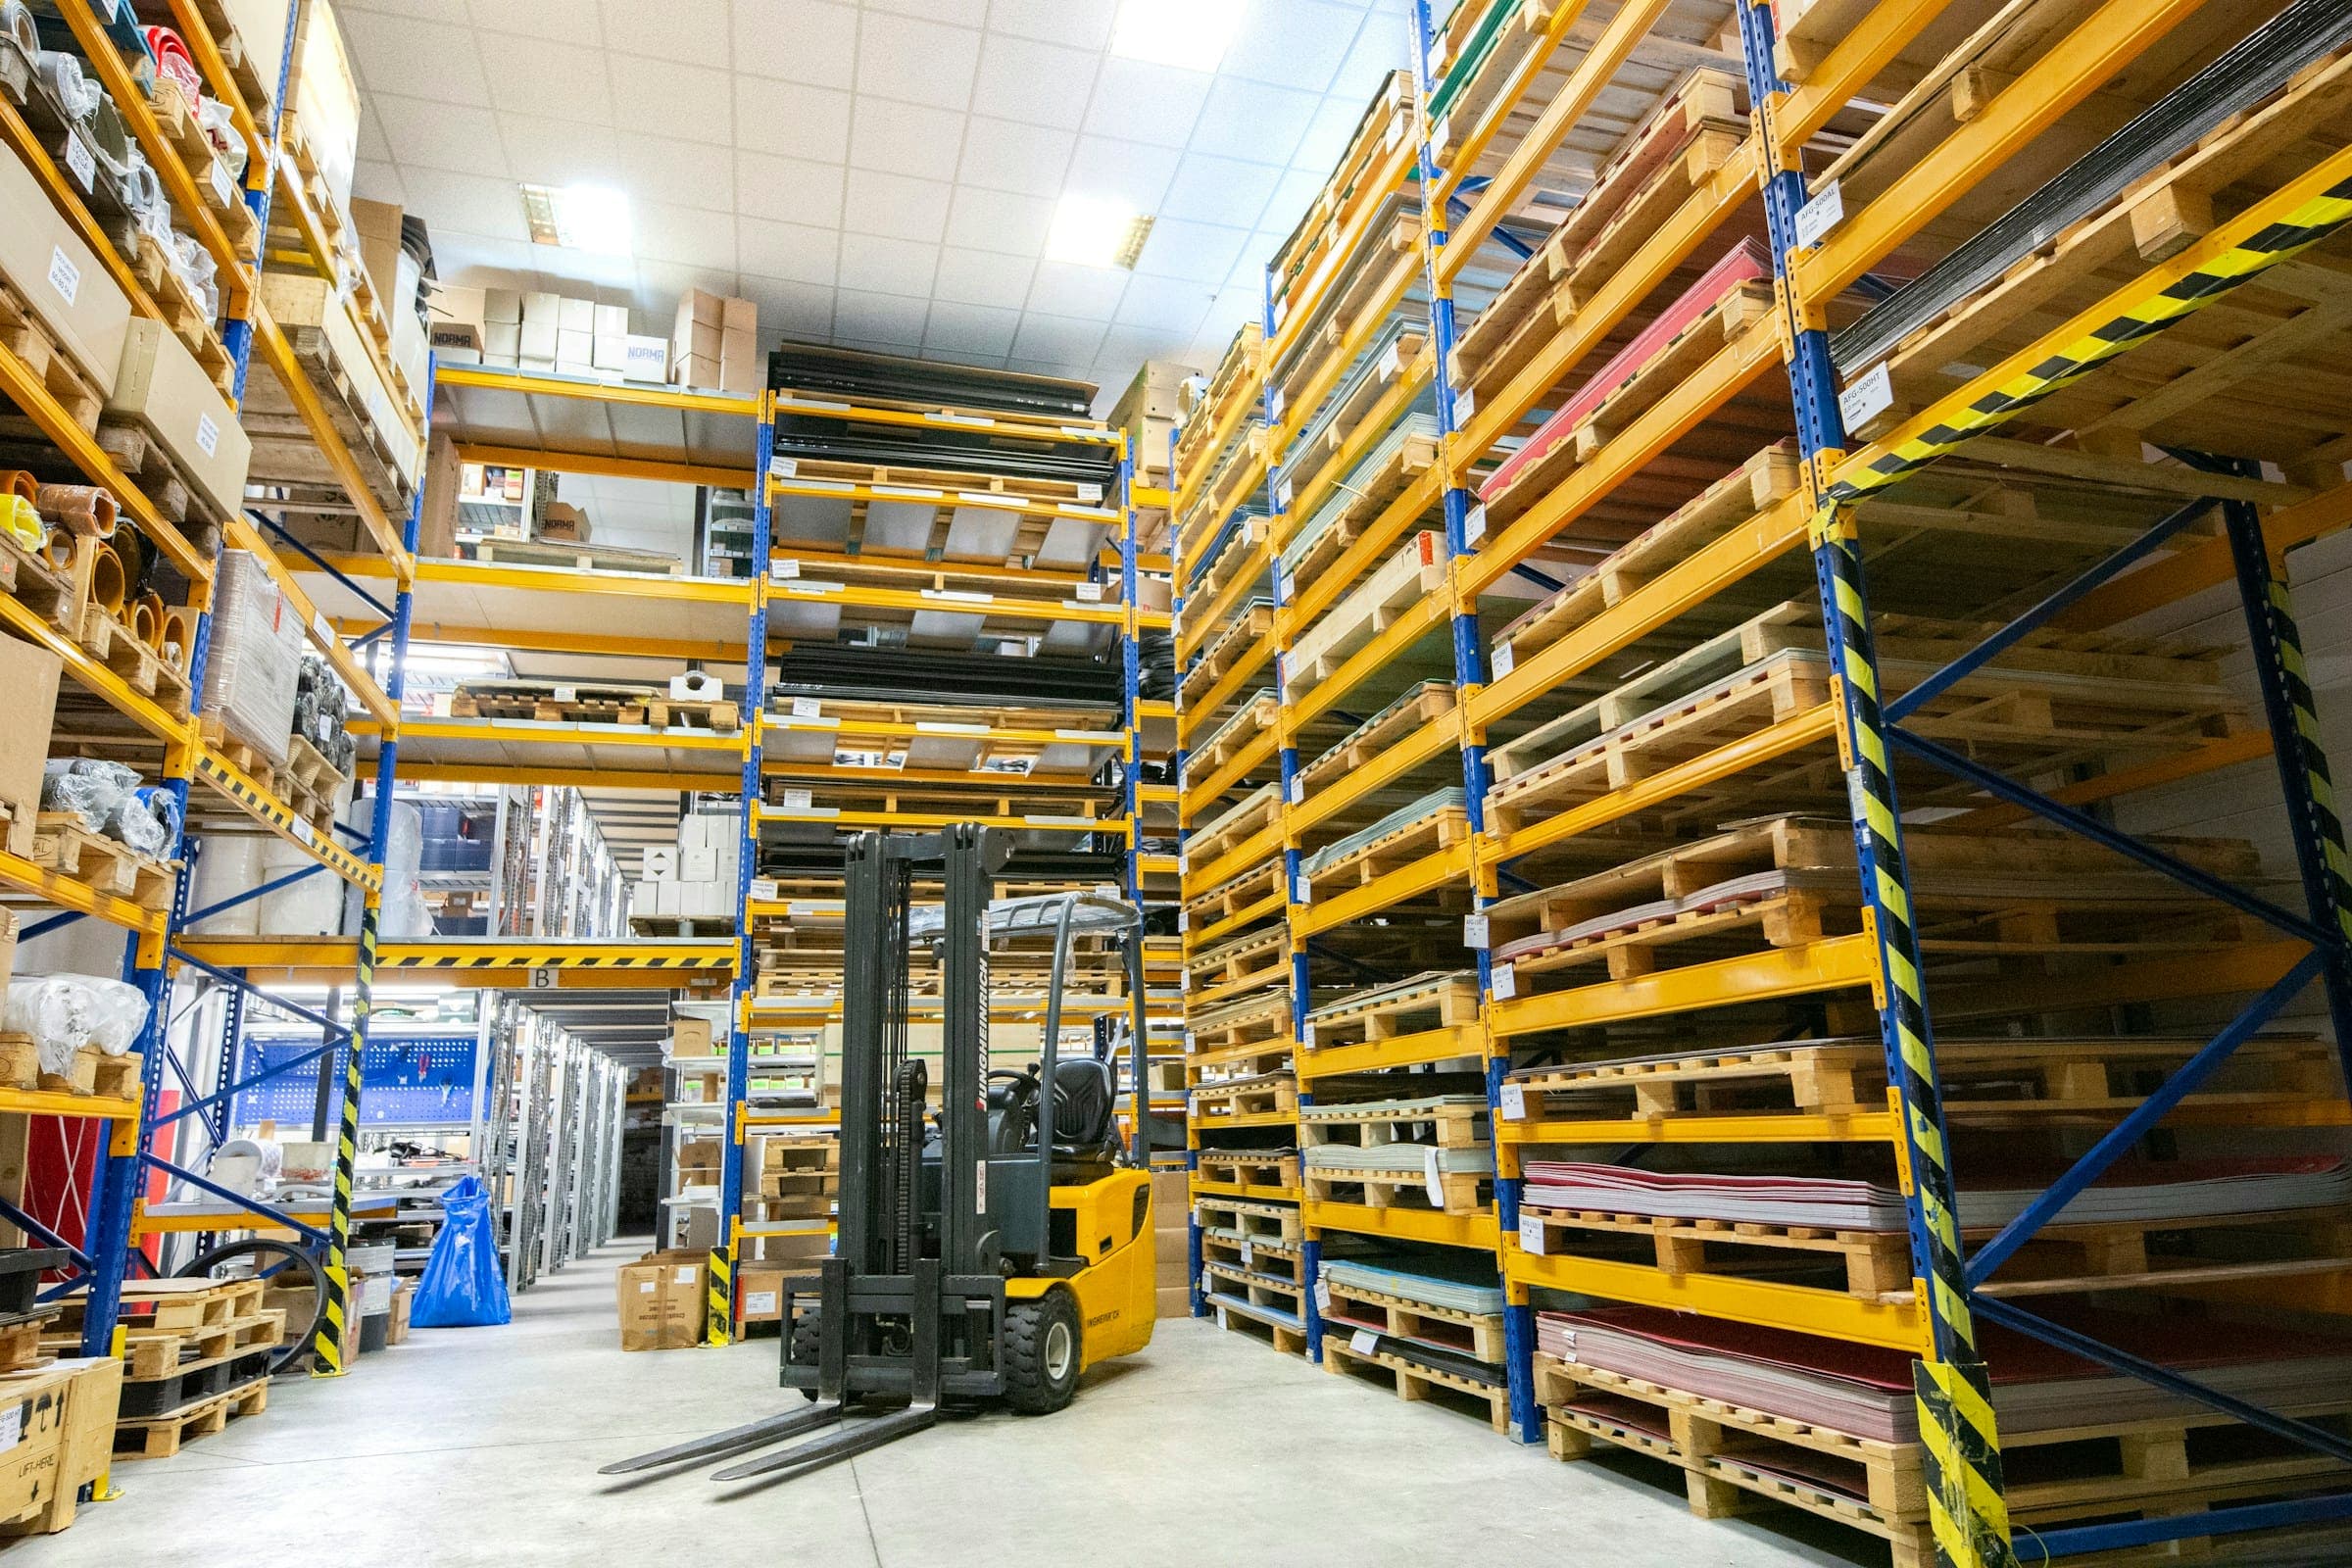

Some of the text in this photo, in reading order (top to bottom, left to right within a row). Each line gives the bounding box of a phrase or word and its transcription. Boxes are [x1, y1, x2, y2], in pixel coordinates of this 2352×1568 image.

[433, 331, 471, 347] NORMA
[627, 345, 664, 363] NORMA
[1843, 371, 1882, 405] AFG-500HT
[544, 518, 575, 531] NORMA
[535, 969, 550, 988] B
[974, 956, 989, 1112] JUNGHEINRICH
